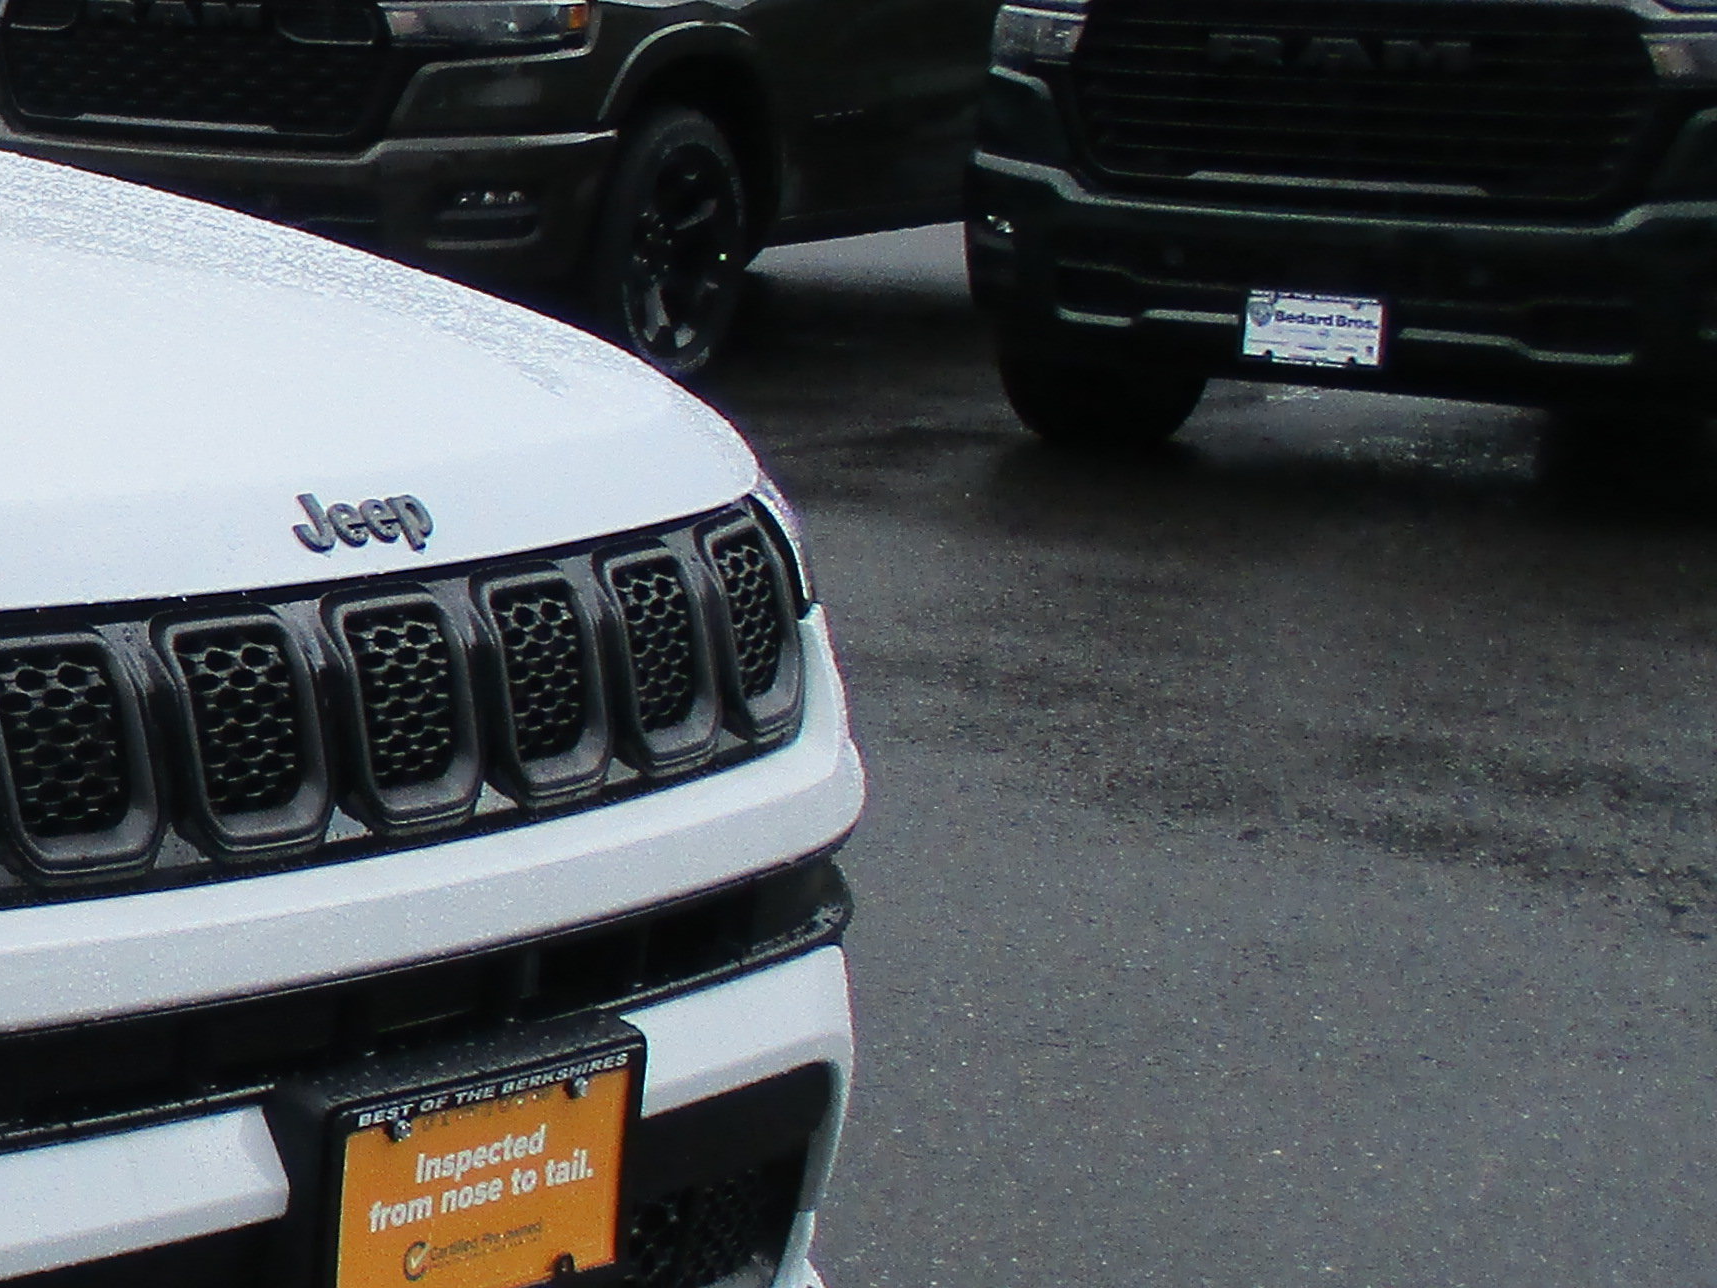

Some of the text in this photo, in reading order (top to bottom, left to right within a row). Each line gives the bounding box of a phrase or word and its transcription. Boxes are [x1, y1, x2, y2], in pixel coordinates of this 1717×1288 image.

[1205, 32, 1473, 72] RAM
[1274, 310, 1379, 330] Bedard Bros.
[291, 492, 434, 554] Jeep
[357, 1103, 415, 1128] BEST
[419, 1095, 450, 1113] OF
[454, 1083, 497, 1106] THE
[500, 1052, 630, 1093] BERKSHIRES
[415, 1122, 548, 1184] Inspected
[368, 1148, 595, 1233] from nose to tail.
